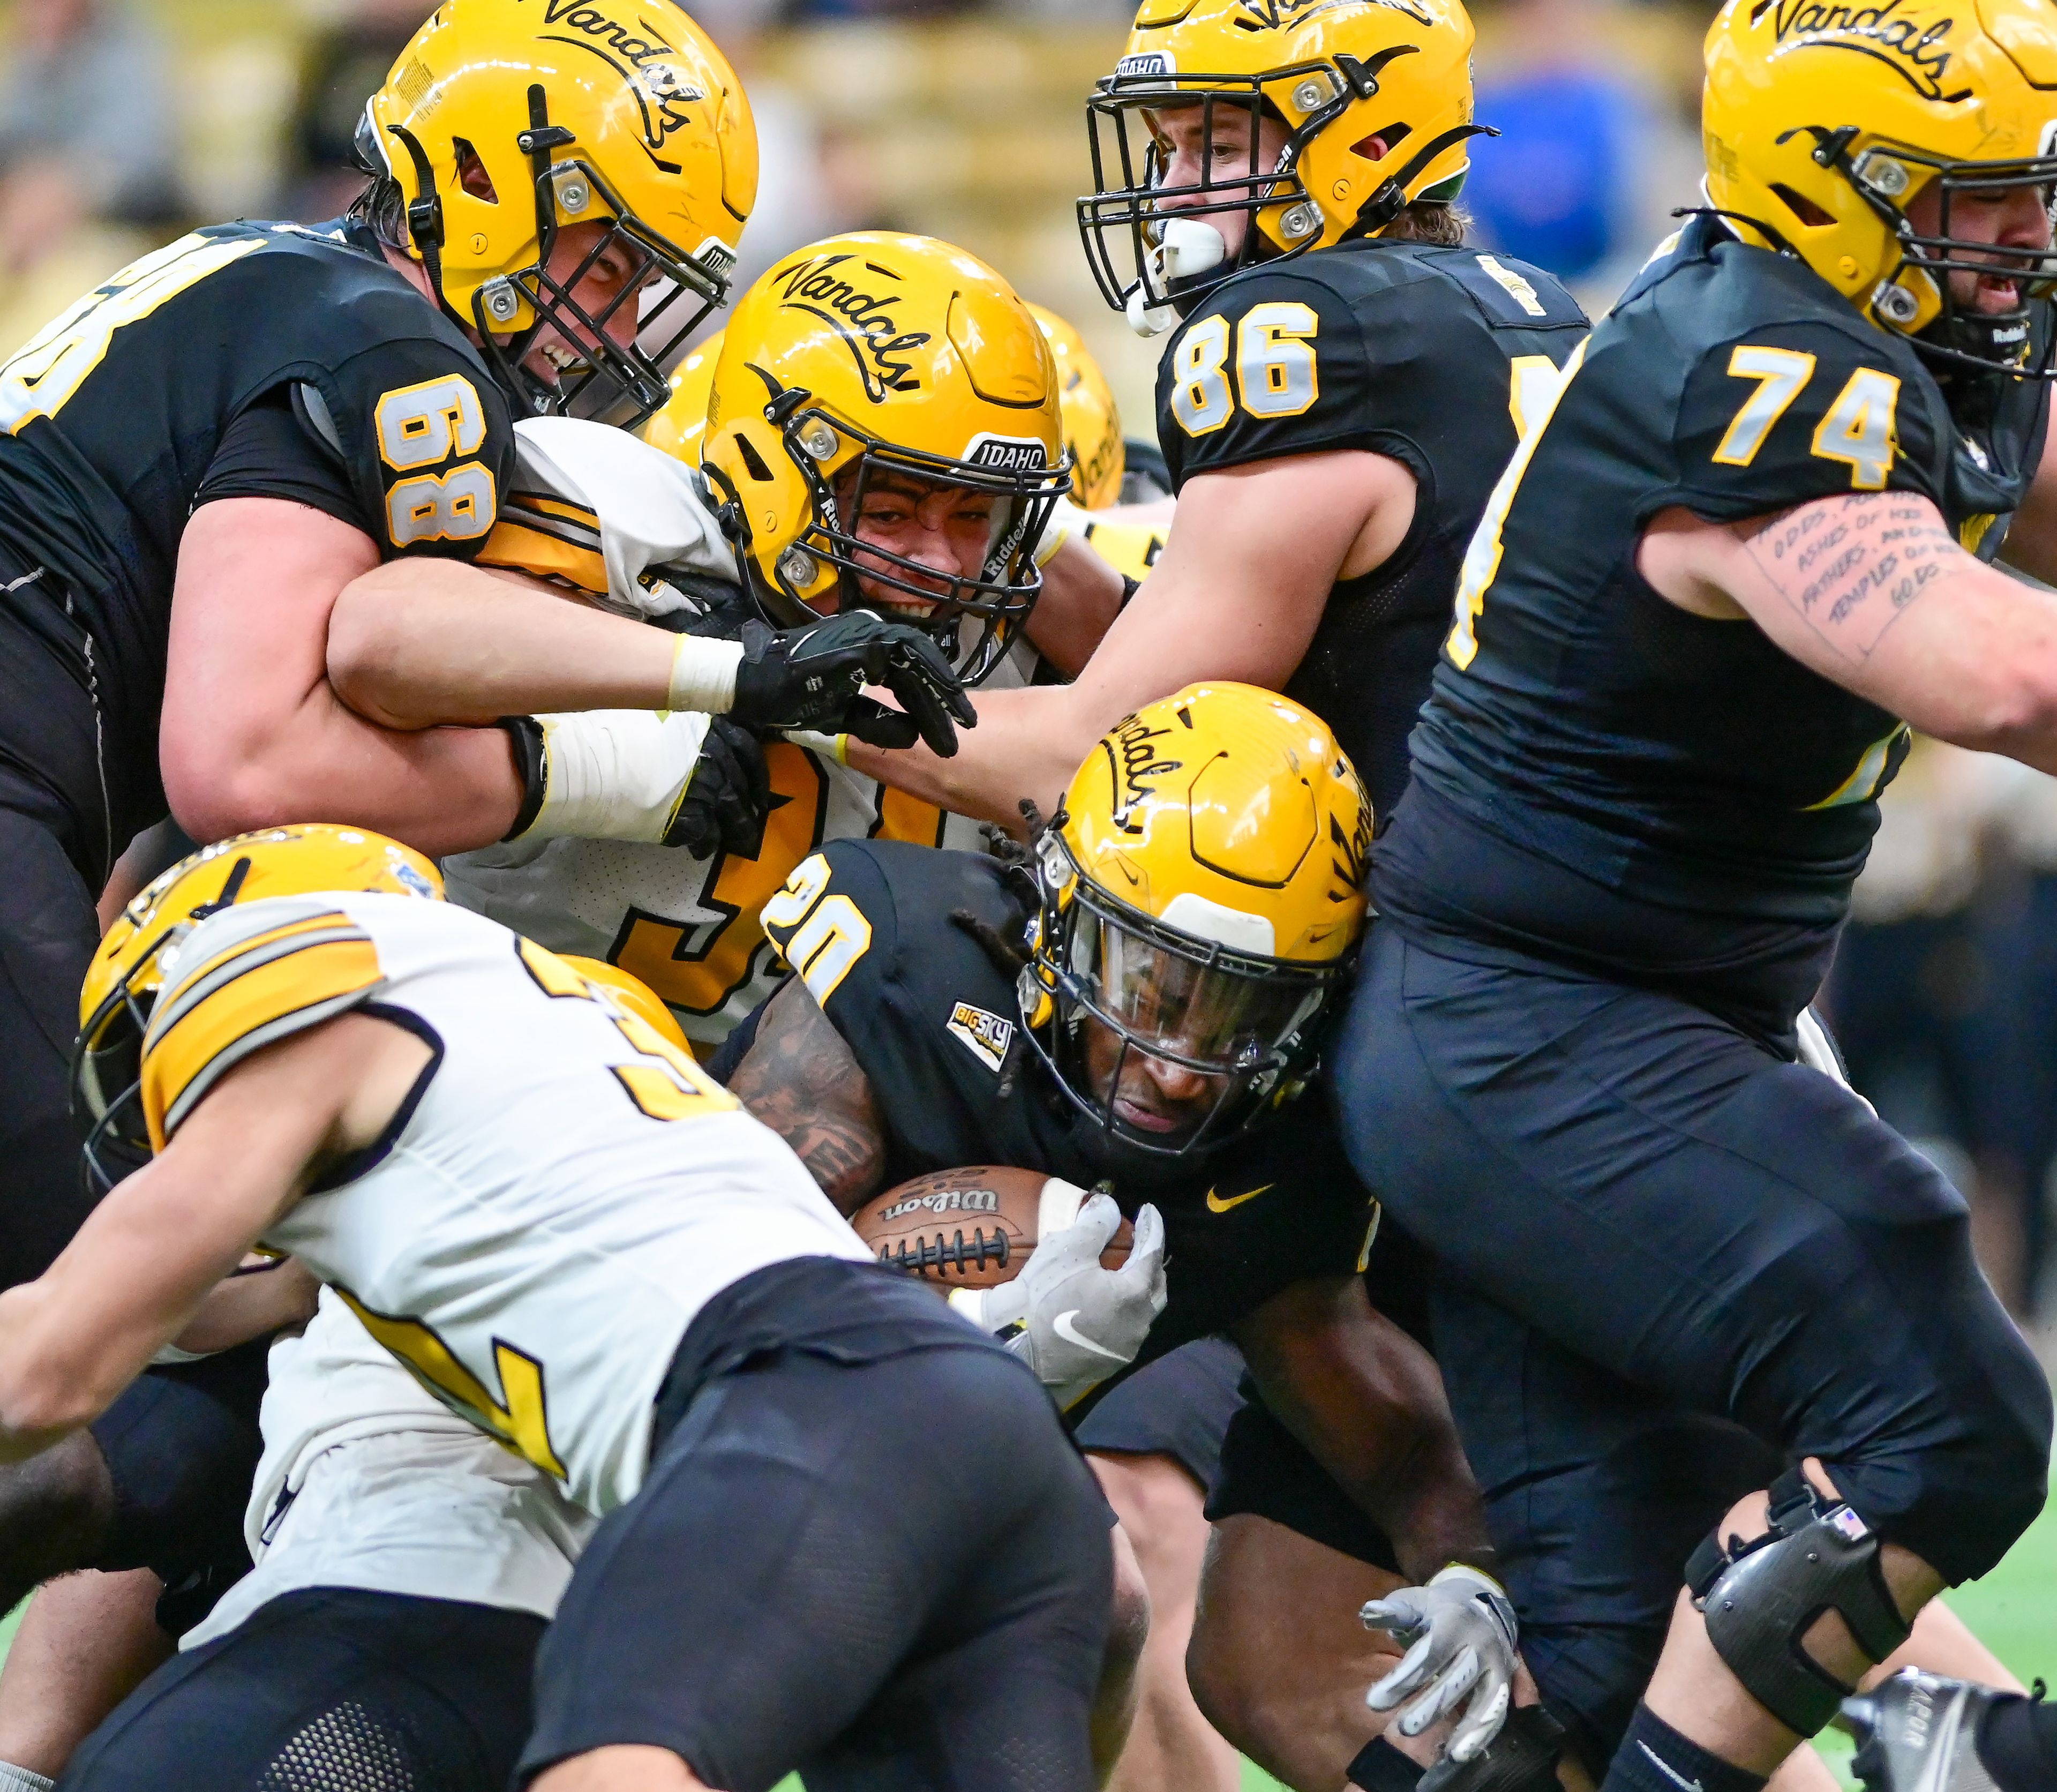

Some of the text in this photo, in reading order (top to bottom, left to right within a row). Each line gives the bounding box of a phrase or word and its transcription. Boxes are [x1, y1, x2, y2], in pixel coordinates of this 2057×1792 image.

[781, 254, 931, 394] Vandals
[1172, 302, 1319, 438] 86
[374, 373, 497, 548] 68
[979, 444, 1042, 470] IDAHO
[1711, 345, 1902, 490] 74
[760, 853, 872, 1010] 20
[882, 1189, 997, 1221] Wilson
